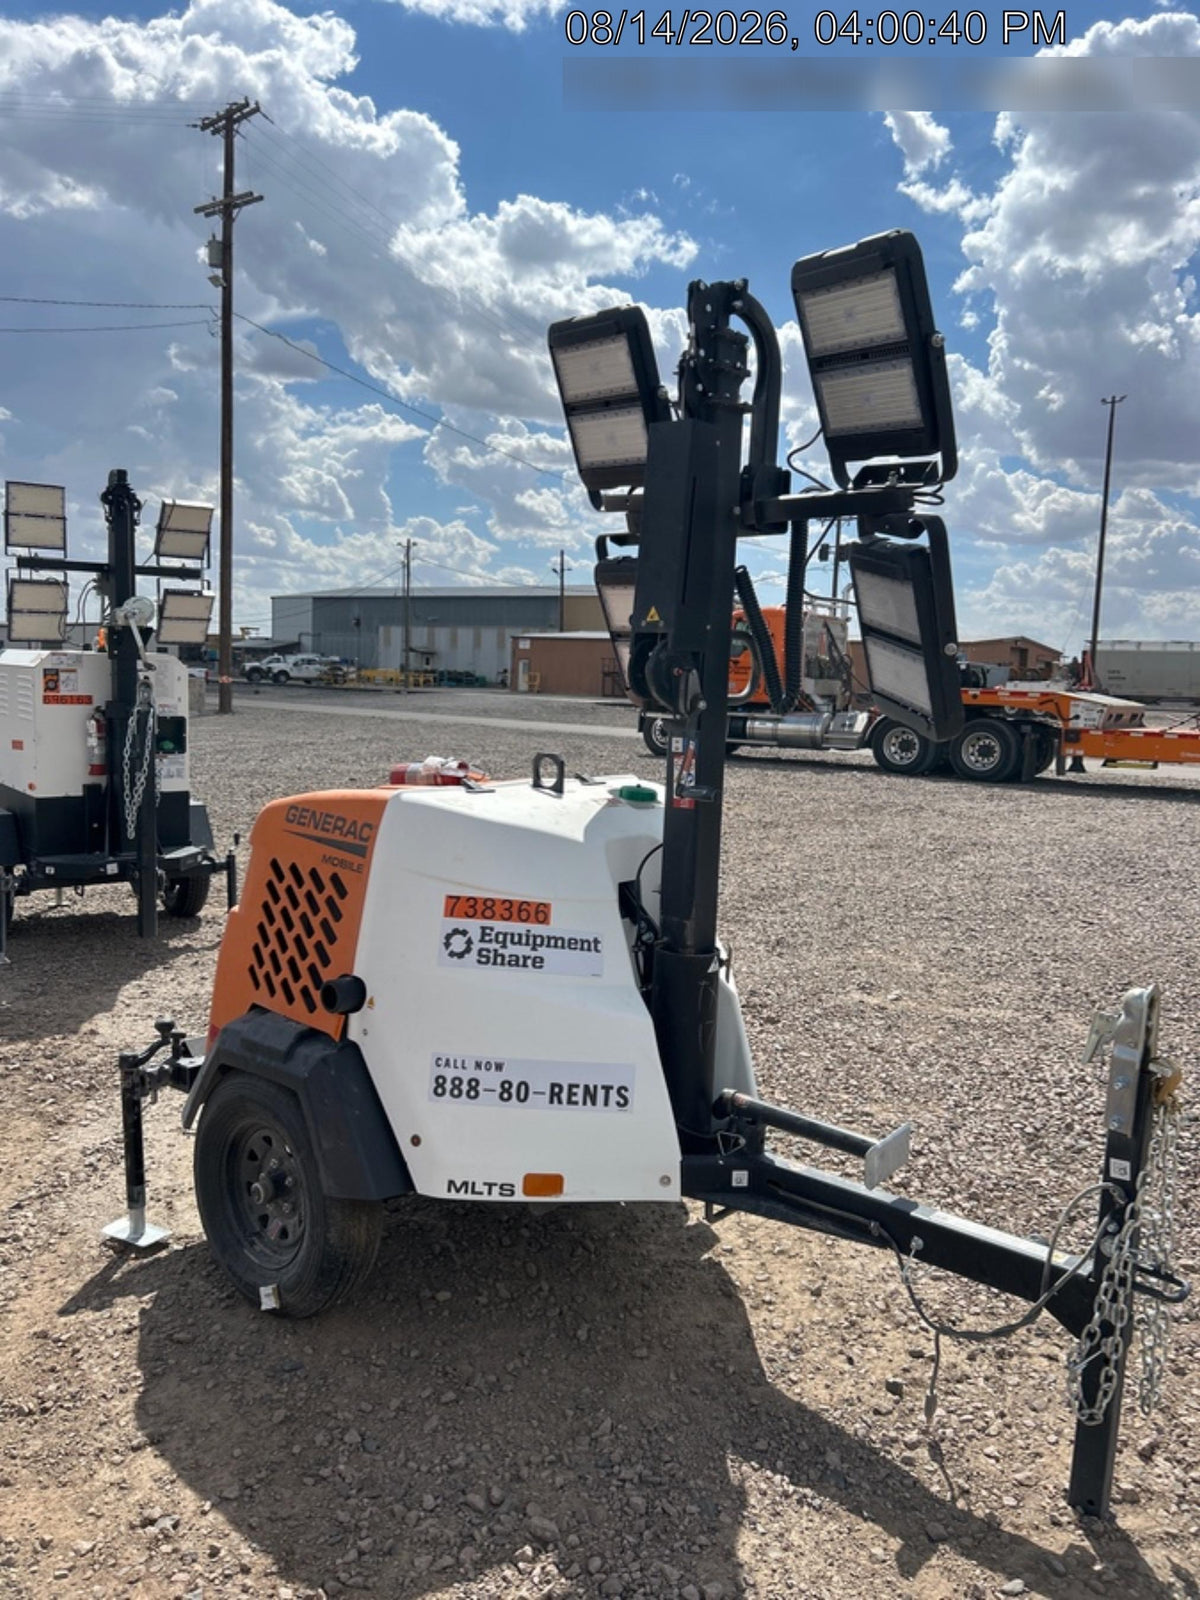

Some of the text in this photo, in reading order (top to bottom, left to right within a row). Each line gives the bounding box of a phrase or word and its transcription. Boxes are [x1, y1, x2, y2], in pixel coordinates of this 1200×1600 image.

[284, 805, 373, 843] GENERAC
[321, 854, 364, 874] MOBILE
[447, 896, 549, 924] 738366
[478, 925, 601, 953] Equipment
[476, 947, 545, 970] Share
[434, 1057, 505, 1072] CALL NOW
[433, 1074, 630, 1108] 888-80-RENTS
[447, 1179, 516, 1197] MLTS
